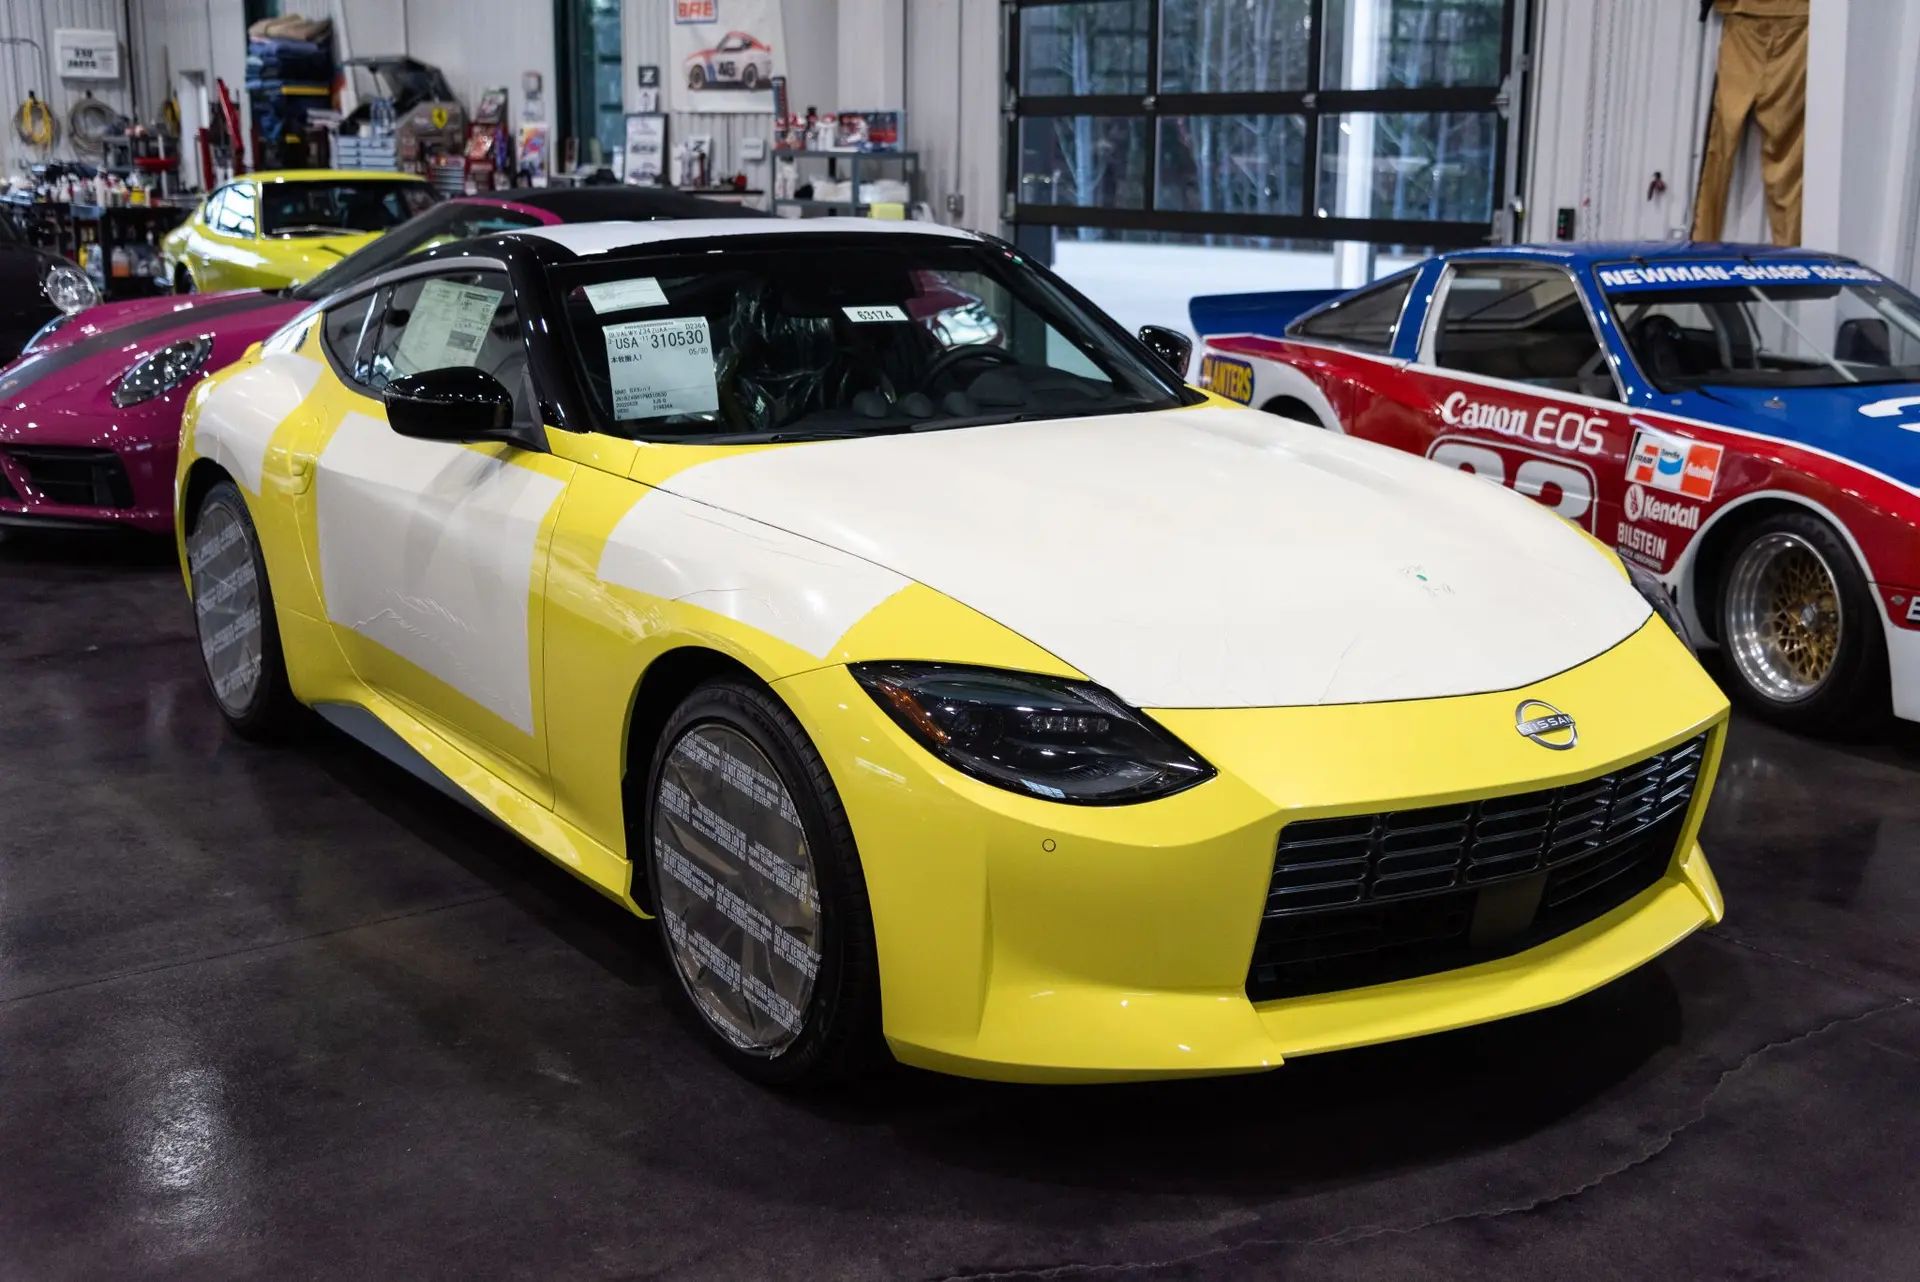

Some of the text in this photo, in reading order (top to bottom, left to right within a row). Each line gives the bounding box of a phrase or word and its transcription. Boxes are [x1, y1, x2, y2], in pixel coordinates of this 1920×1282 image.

[678, 1, 713, 17] BRE
[1600, 265, 1811, 287] NEWMAN-SHARP
[857, 310, 893, 320] 63174
[615, 337, 639, 349] USA
[651, 329, 704, 349] 310530
[1441, 391, 1609, 455] Canon EOS
[1643, 495, 1700, 530] Kendall
[1617, 521, 1667, 560] BILSTEIN
[1522, 715, 1574, 733] NISSAN
